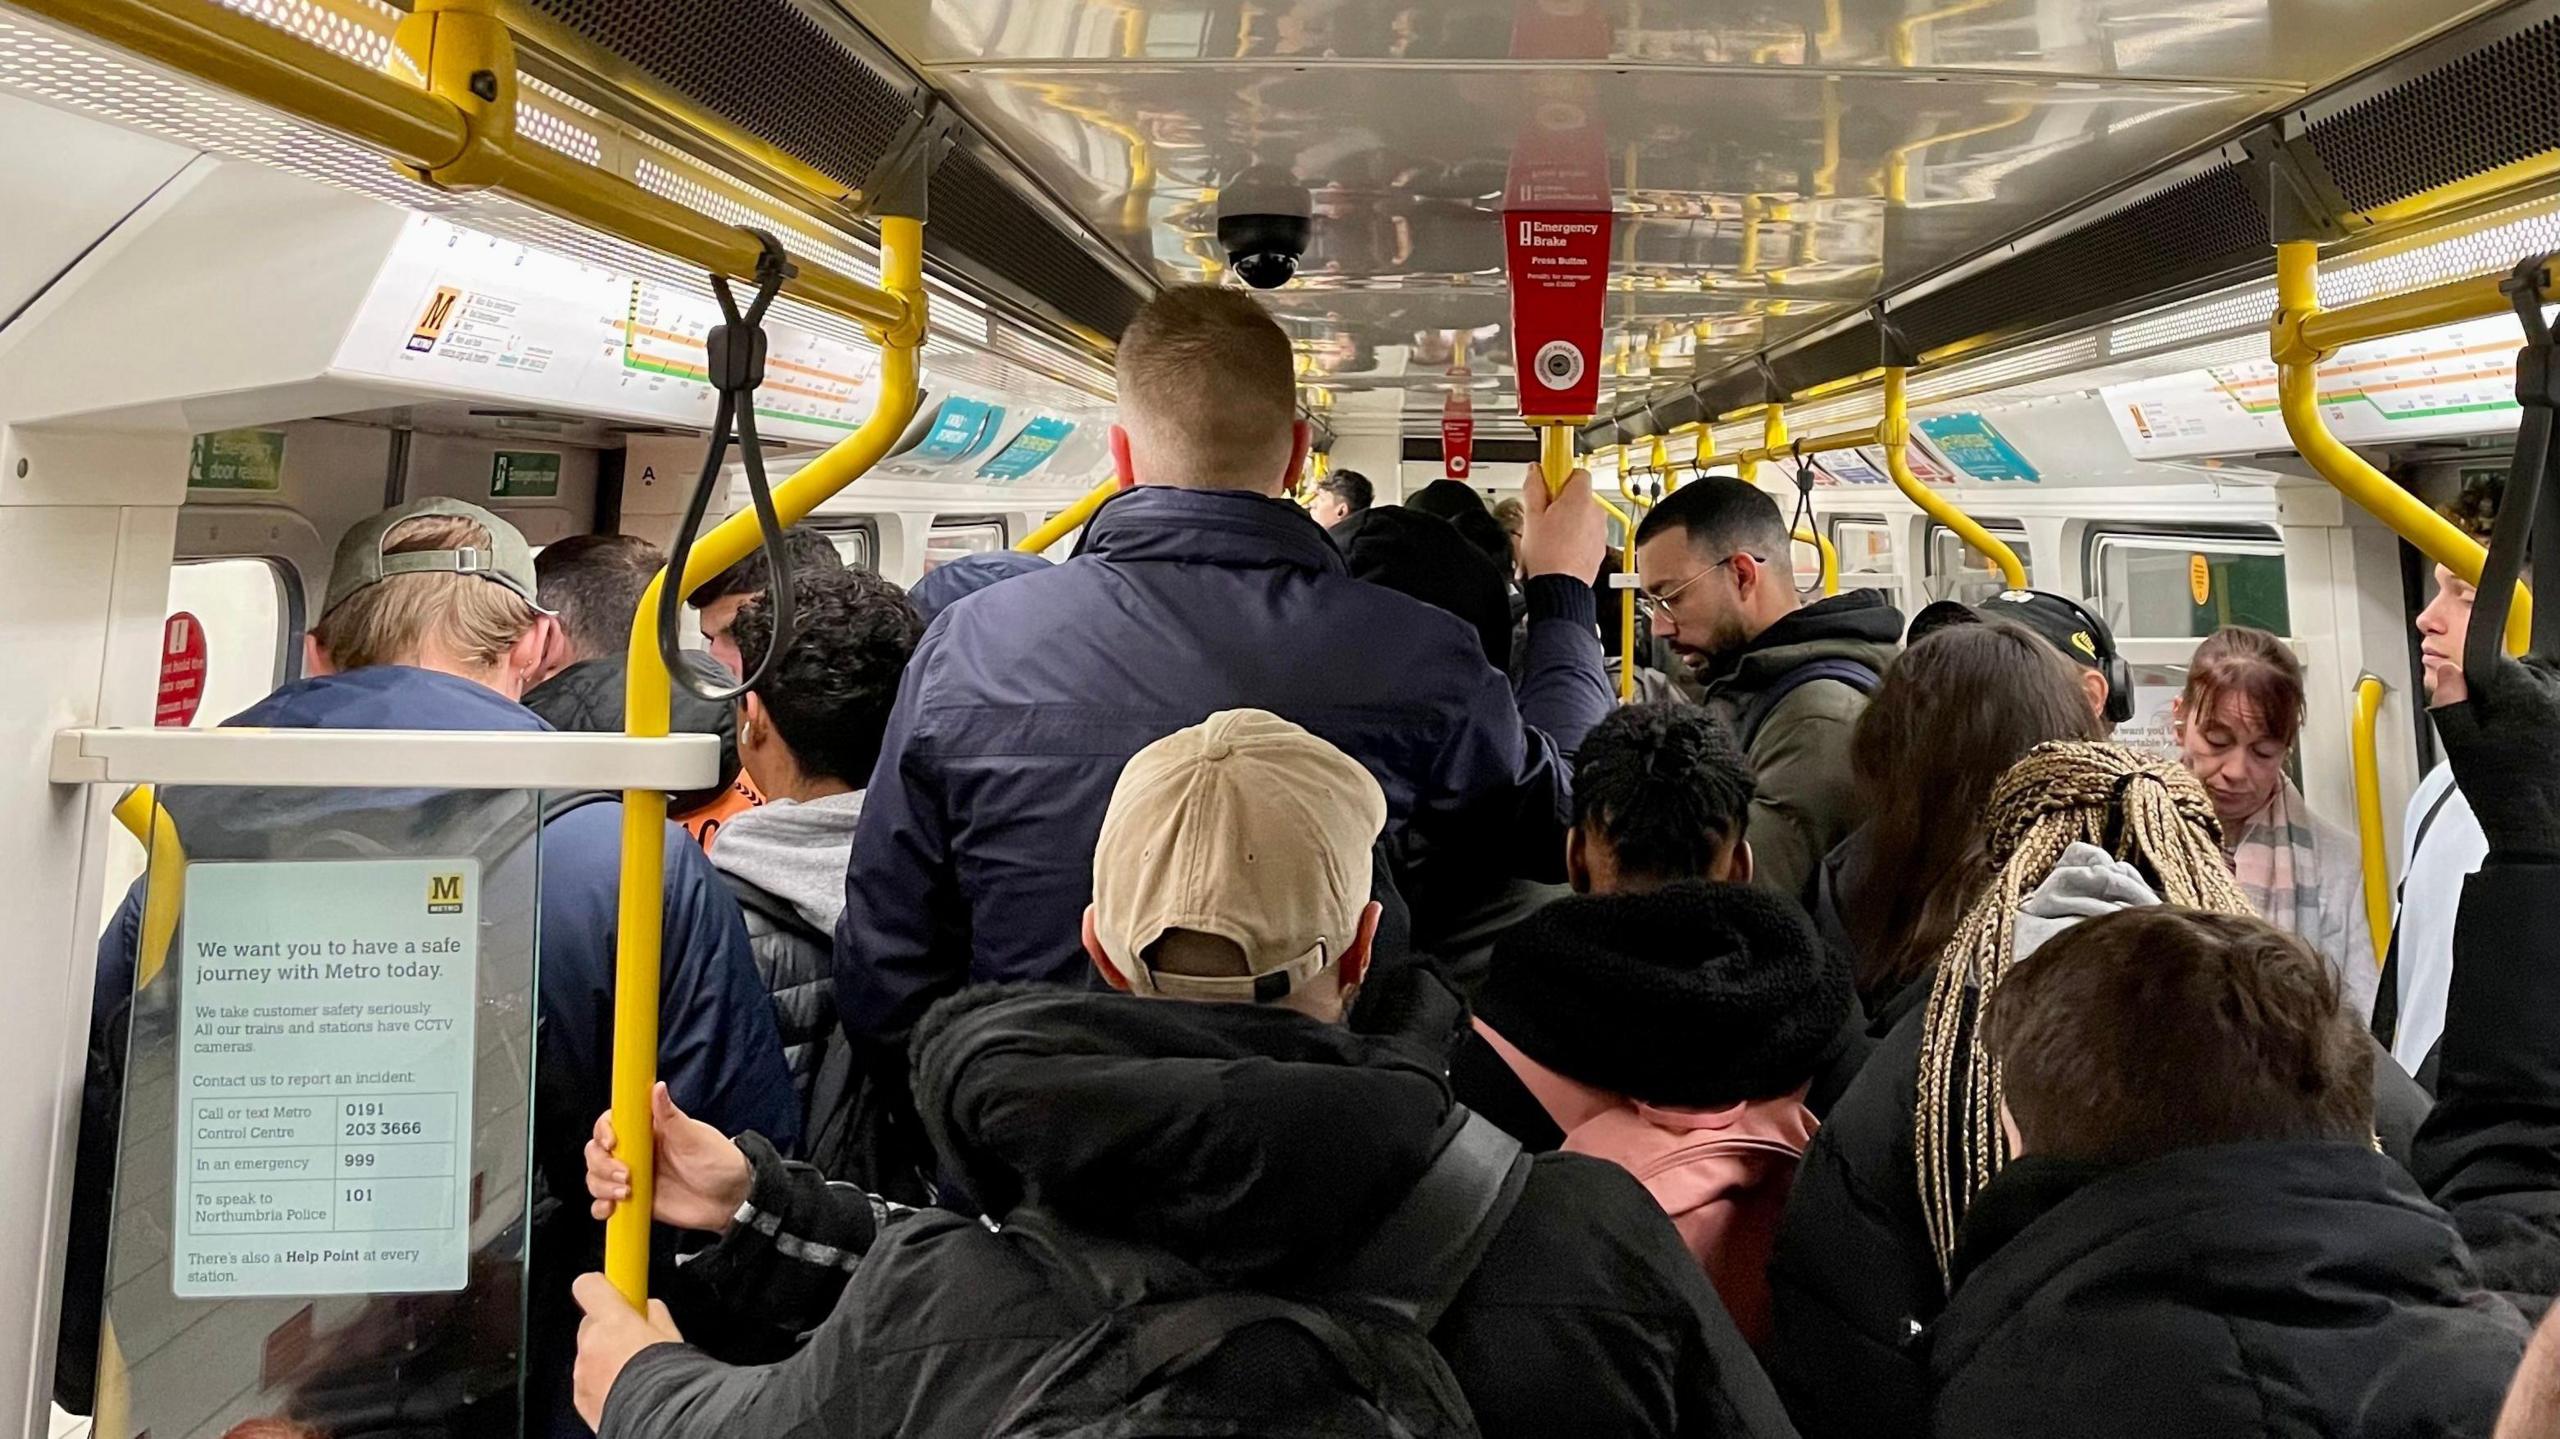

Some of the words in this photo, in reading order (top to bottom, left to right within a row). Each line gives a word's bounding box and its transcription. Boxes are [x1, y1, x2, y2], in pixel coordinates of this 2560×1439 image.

[1533, 221, 1598, 234] Emergency
[1533, 236, 1567, 246] Brake
[1531, 256, 1556, 265] Press
[1558, 257, 1588, 265] Button
[642, 466, 656, 480] A
[432, 876, 459, 899] M
[198, 942, 226, 957] We
[234, 942, 280, 957] want
[288, 943, 321, 959] you
[329, 941, 346, 955] to
[353, 939, 398, 954] have
[405, 943, 416, 953] a
[422, 938, 461, 953] safe
[196, 967, 270, 984] journey
[278, 964, 318, 980] with
[325, 964, 380, 979] Metro
[388, 962, 443, 980] today.
[195, 1006, 216, 1017] We
[221, 1005, 248, 1017] take
[253, 1006, 317, 1017] customer
[322, 1003, 363, 1017] safety
[195, 1023, 212, 1035] All
[217, 1025, 240, 1035] our
[245, 1023, 284, 1034] trains
[288, 1022, 314, 1033] and
[319, 1022, 373, 1033] stations
[378, 1020, 410, 1032] have
[414, 1019, 453, 1031] CCTV
[193, 1075, 246, 1087] Contact
[251, 1076, 266, 1086] us
[271, 1075, 283, 1086] to
[288, 1074, 330, 1087] report
[335, 1074, 351, 1084] an
[356, 1072, 415, 1084] incident:
[198, 1108, 223, 1120] Call
[228, 1109, 241, 1119] or
[246, 1108, 269, 1119] text
[274, 1107, 311, 1118] Metro
[346, 1103, 384, 1116] 0191
[198, 1127, 246, 1139] Control
[250, 1127, 294, 1138] Centre
[345, 1123, 375, 1135] 203
[382, 1122, 421, 1135] 3666
[197, 1158, 210, 1170] In
[214, 1160, 229, 1170] an
[234, 1158, 309, 1172] emergency
[345, 1154, 375, 1166] 999
[196, 1194, 211, 1205] To
[216, 1194, 255, 1205] speak
[260, 1194, 272, 1204] to
[345, 1189, 373, 1202] 101
[195, 1210, 282, 1222] Northumbria
[287, 1209, 326, 1221] Police
[189, 1252, 237, 1264] There's
[242, 1252, 269, 1264] also
[274, 1254, 282, 1263] a
[286, 1251, 318, 1264] Help
[323, 1250, 359, 1262] Point
[363, 1250, 376, 1261] at
[381, 1250, 419, 1263] every
[188, 1270, 238, 1283] station.
